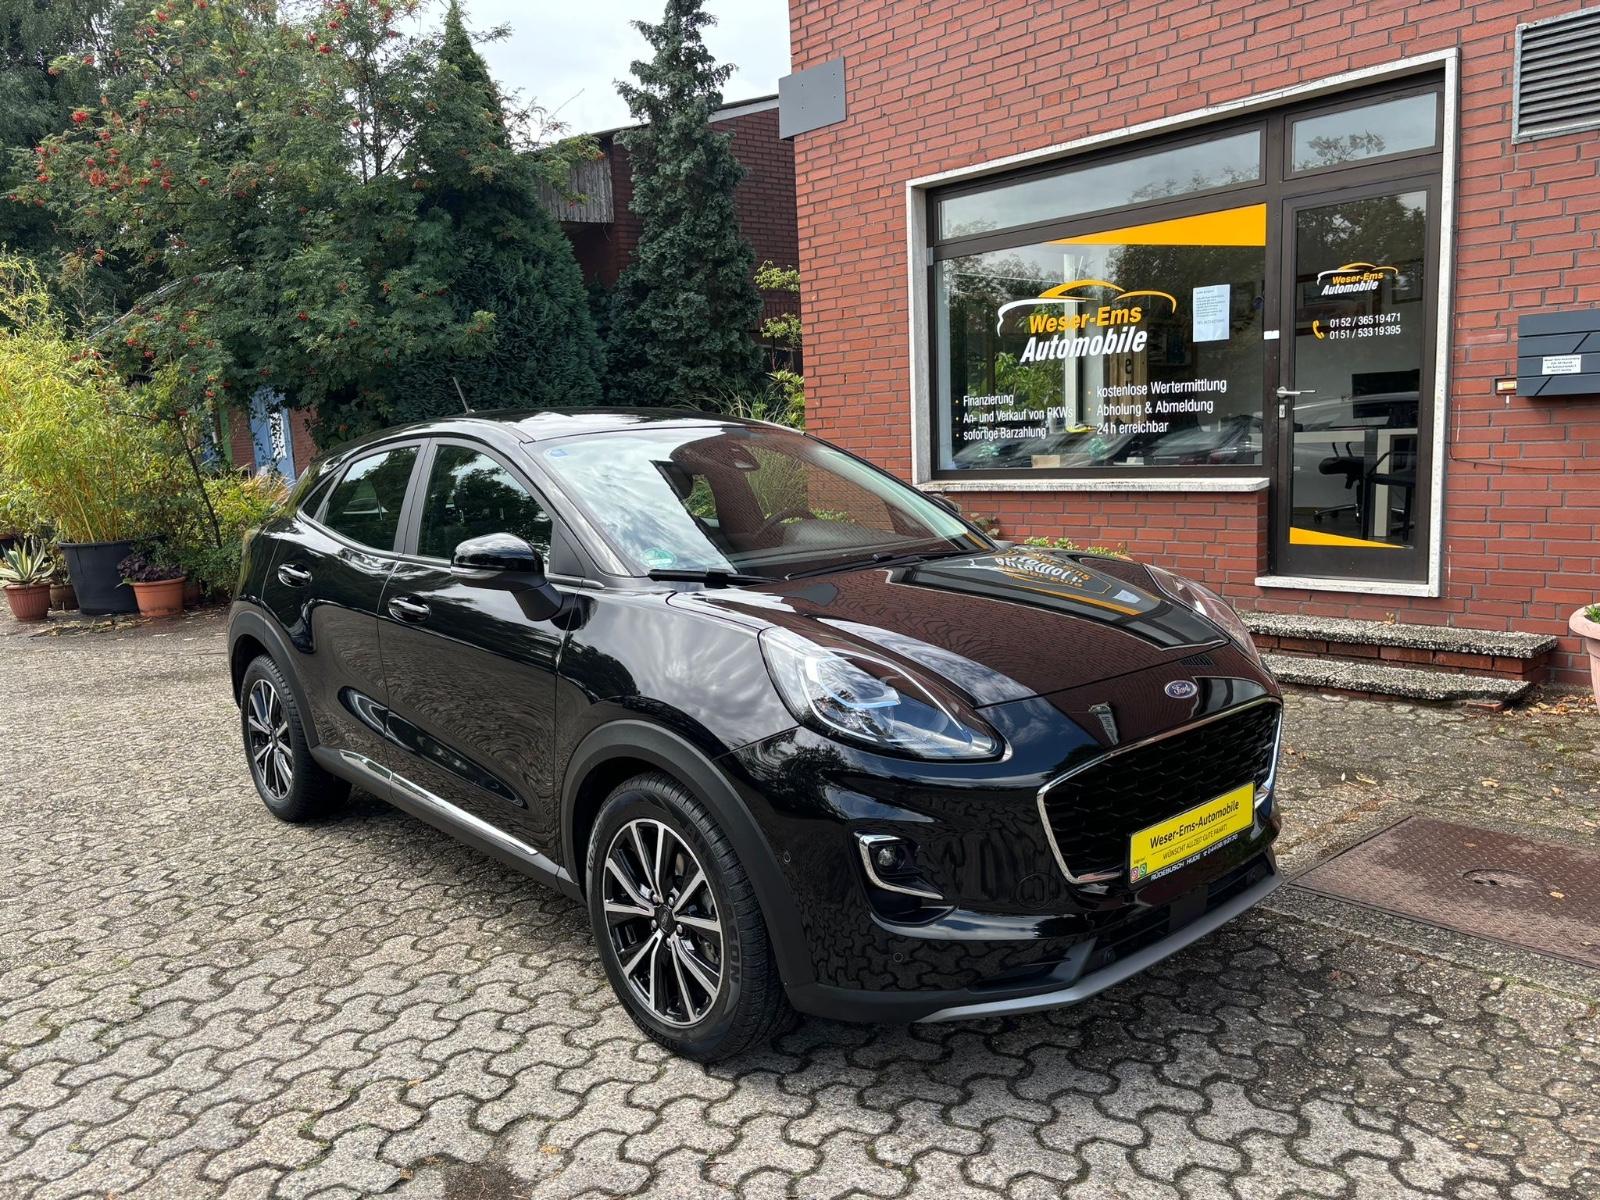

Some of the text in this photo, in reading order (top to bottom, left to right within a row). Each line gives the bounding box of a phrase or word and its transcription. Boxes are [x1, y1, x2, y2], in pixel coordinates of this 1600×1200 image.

[1332, 272, 1384, 285] Weser-Ems
[1321, 280, 1379, 295] Automobile
[1029, 306, 1142, 334] Weser-Ems
[1020, 326, 1148, 363] Automobile
[1096, 378, 1227, 397] kostenlose Wertermittlung
[963, 394, 1014, 407] Finanzierung
[1096, 399, 1214, 416] Abholung & Abmeldung
[963, 406, 1073, 424] An- und Verkauf von PKWs
[963, 426, 1047, 441] sofortige Barzahlung
[1119, 421, 1169, 434] erreichbar
[1150, 800, 1239, 849] Weser-Ems-Automobile
